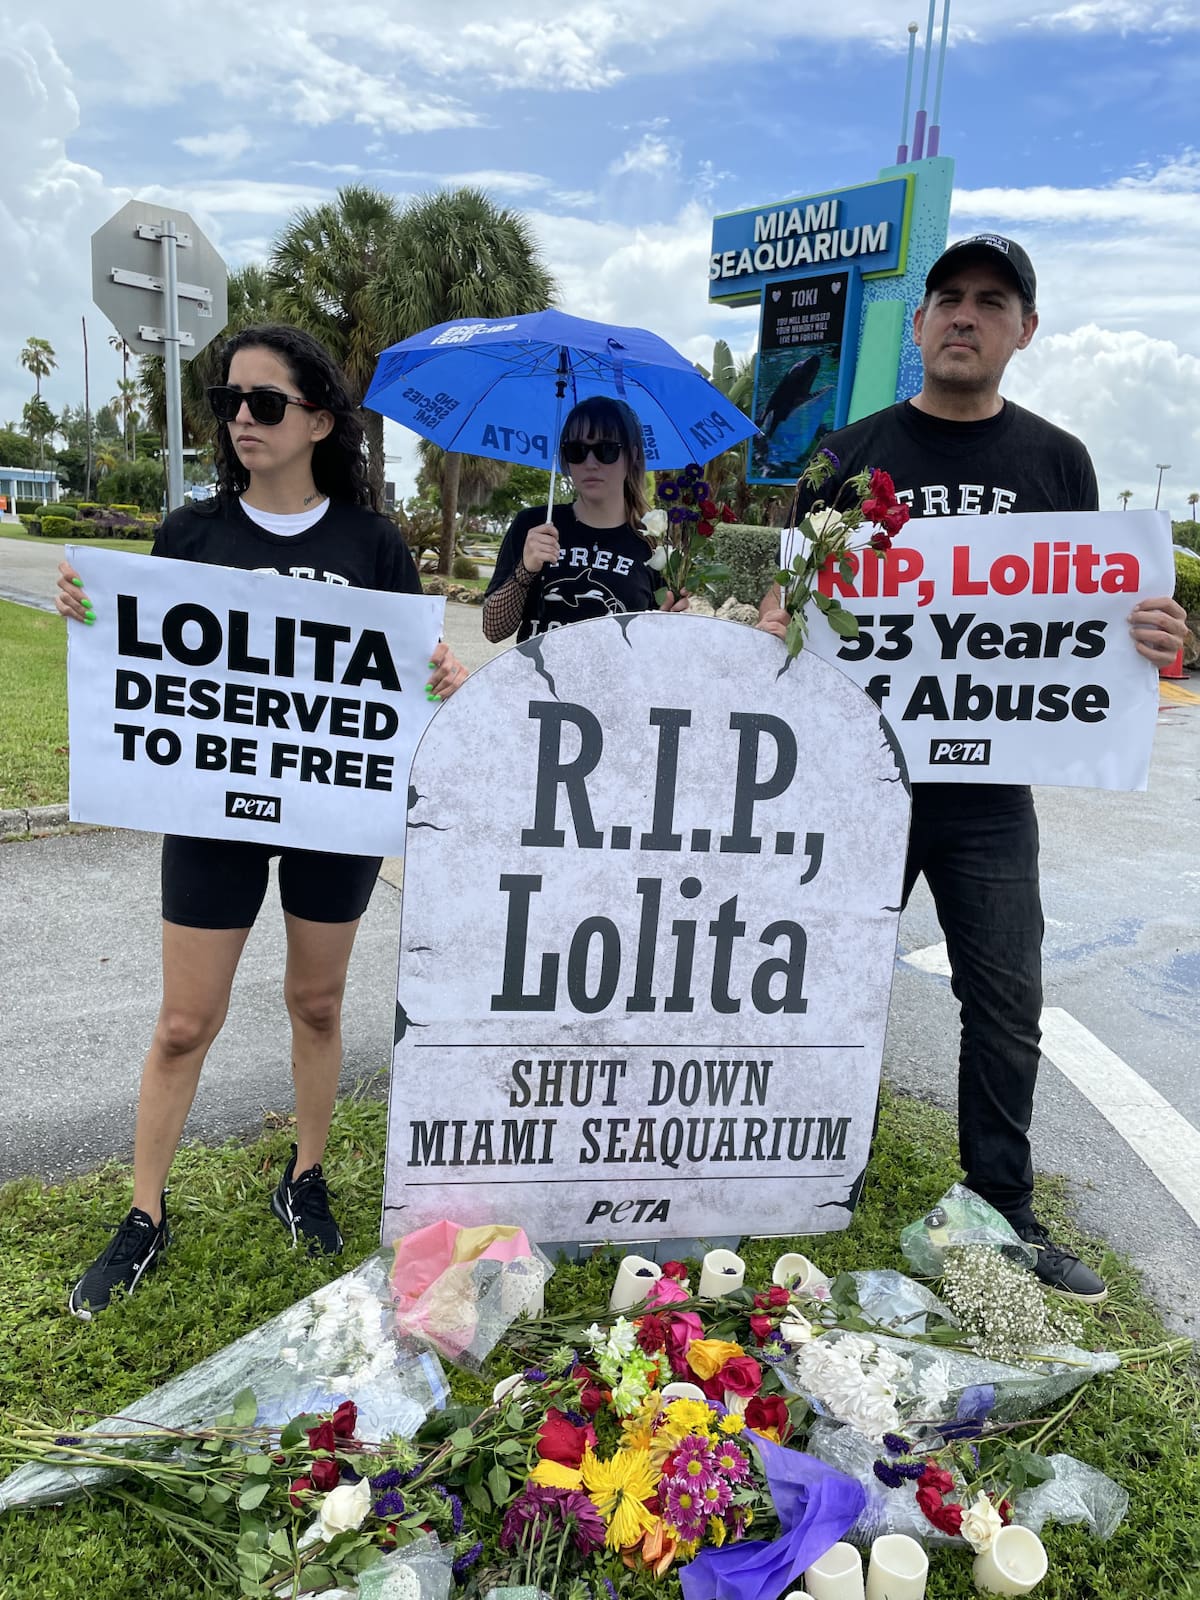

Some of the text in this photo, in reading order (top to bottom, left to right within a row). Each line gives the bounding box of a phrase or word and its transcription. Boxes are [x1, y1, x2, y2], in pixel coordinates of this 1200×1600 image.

[754, 200, 839, 242] MIAMI
[709, 222, 889, 280] SEAQUARIUM
[791, 288, 818, 308] TOKI
[810, 312, 830, 322] MISSED
[790, 323, 814, 334] MEMORY
[814, 321, 828, 331] WILL
[799, 331, 824, 342] FOREVER
[817, 541, 1140, 608] RIP, Lolita
[117, 594, 402, 692] LOLITA
[836, 613, 1108, 662] 53 Years
[115, 669, 399, 741] DESERVED
[864, 674, 1110, 723] f Abuse
[114, 723, 395, 792] TO BE FREE
[520, 700, 825, 886] R.I.P.,
[490, 873, 809, 1015] Lolita
[509, 1059, 774, 1109] SHUT DOWN
[406, 1117, 852, 1170] MIAMI SEAQUARIUM
